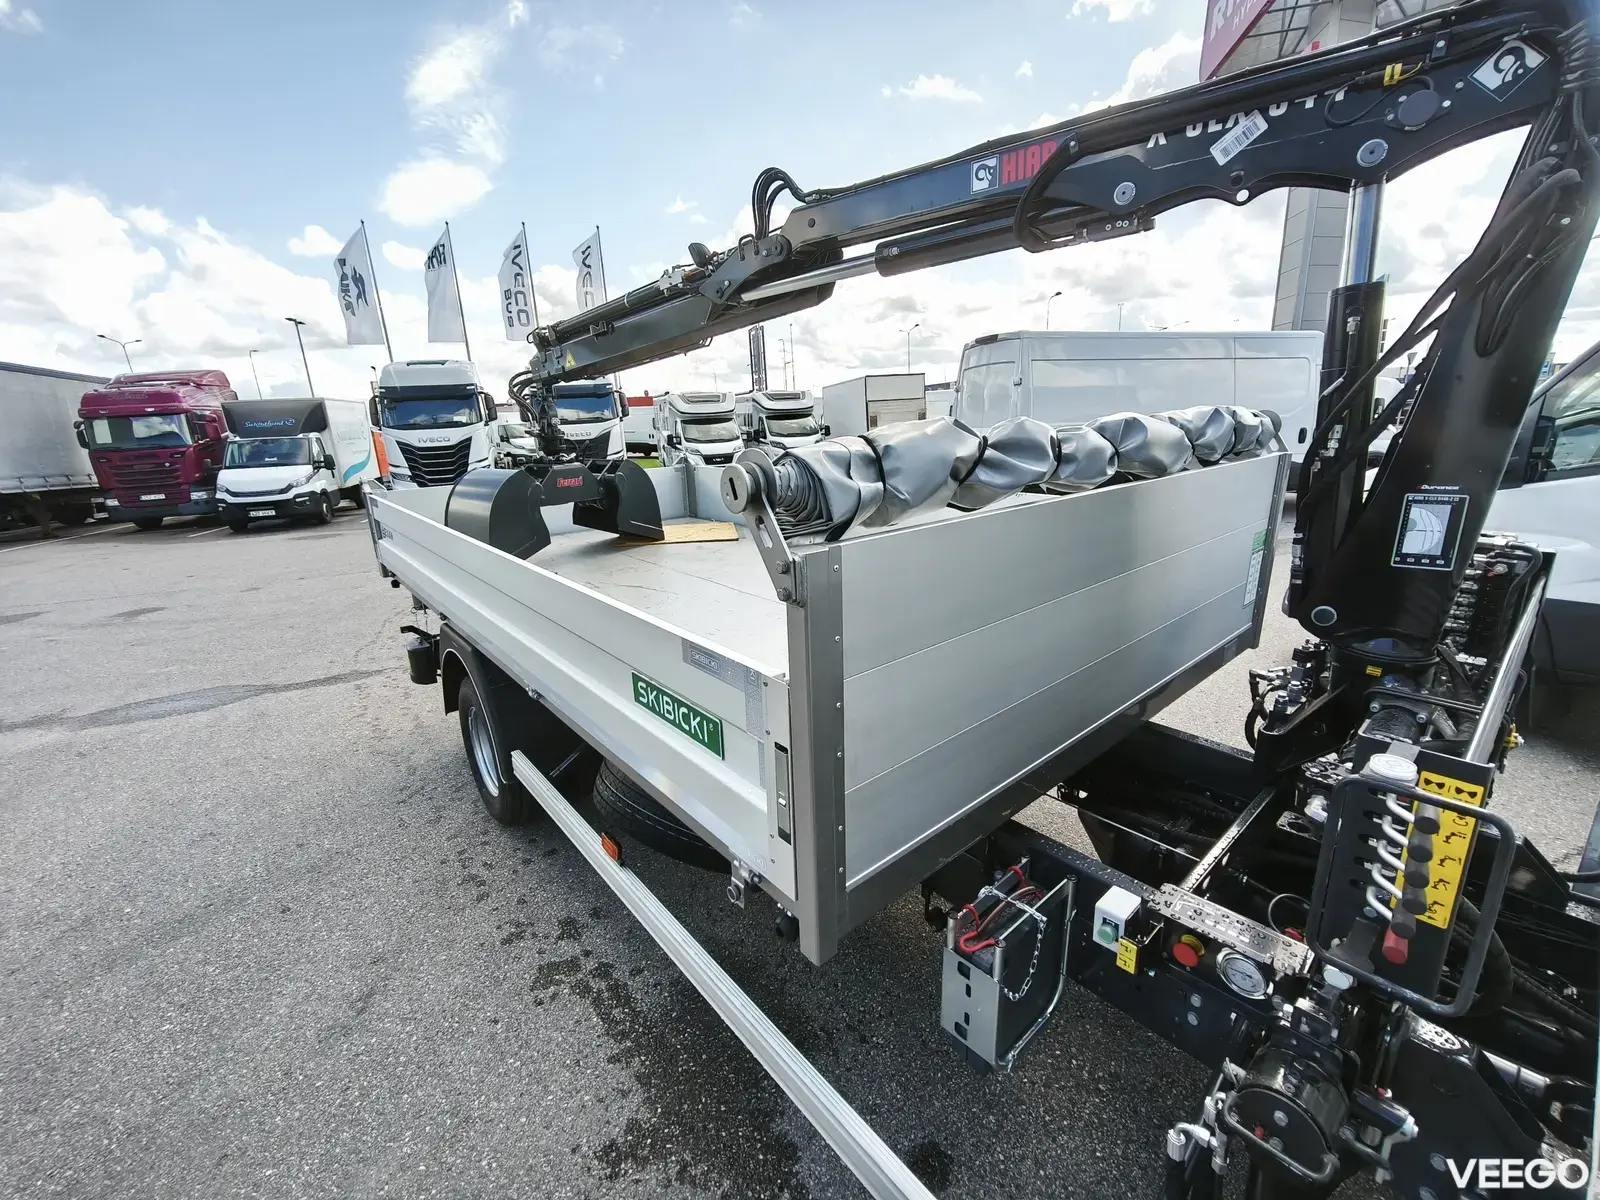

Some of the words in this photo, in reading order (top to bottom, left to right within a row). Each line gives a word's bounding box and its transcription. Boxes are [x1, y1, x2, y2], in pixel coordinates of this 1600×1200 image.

[511, 244, 531, 327] IVECO
[504, 288, 515, 328] BUS
[417, 436, 451, 444] IVECO
[691, 651, 718, 670] SKIBICKI
